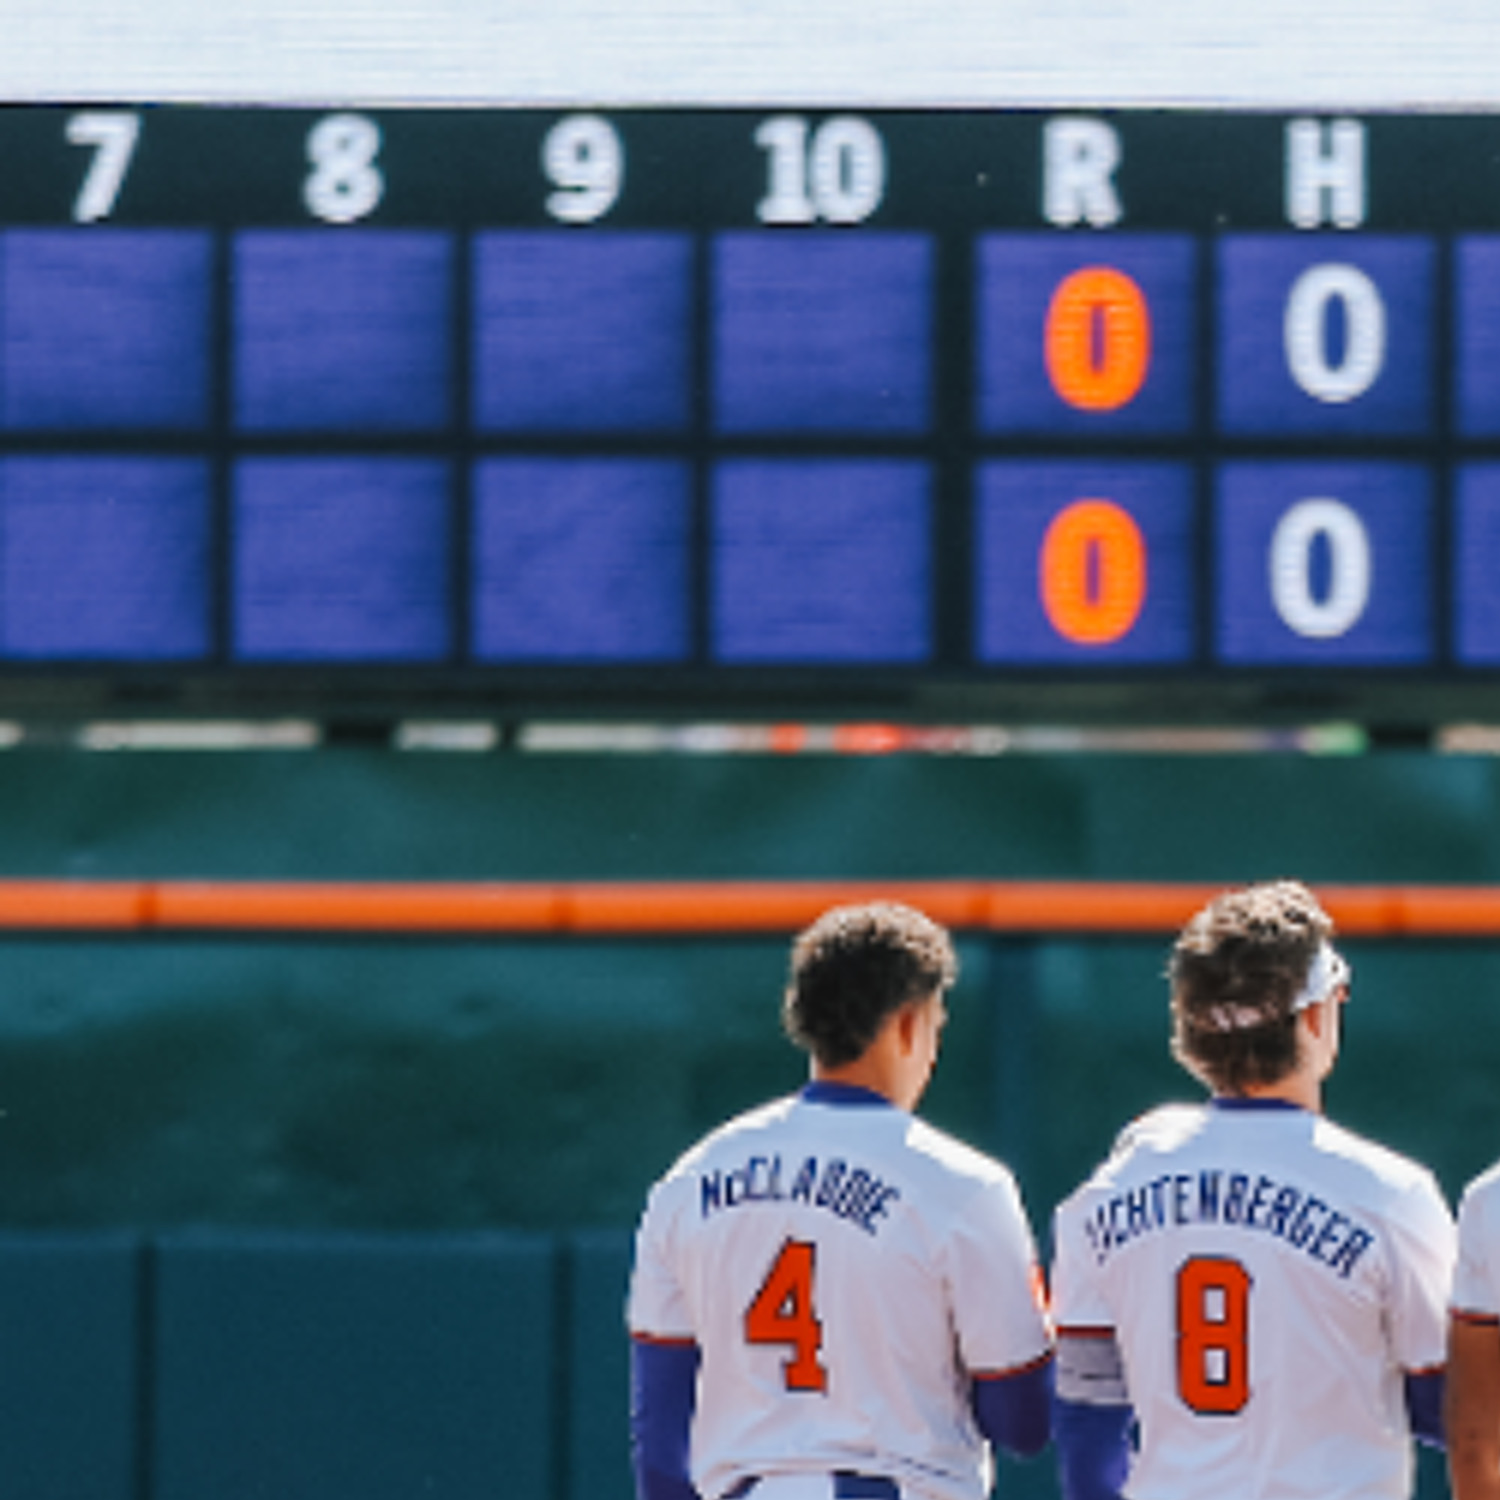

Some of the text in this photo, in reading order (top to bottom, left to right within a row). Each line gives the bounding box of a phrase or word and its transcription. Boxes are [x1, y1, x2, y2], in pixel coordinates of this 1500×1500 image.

[65, 111, 140, 223] 7
[304, 113, 384, 224] 8
[543, 114, 624, 223] 9
[755, 116, 885, 225] 10
[1042, 117, 1122, 228] R
[1286, 117, 1366, 229] H
[1043, 266, 1151, 411] 0
[1283, 262, 1386, 404] 0
[1039, 498, 1147, 646] 0
[1269, 497, 1372, 639] 0
[744, 1238, 828, 1393] 4
[1174, 1254, 1252, 1416] 8
